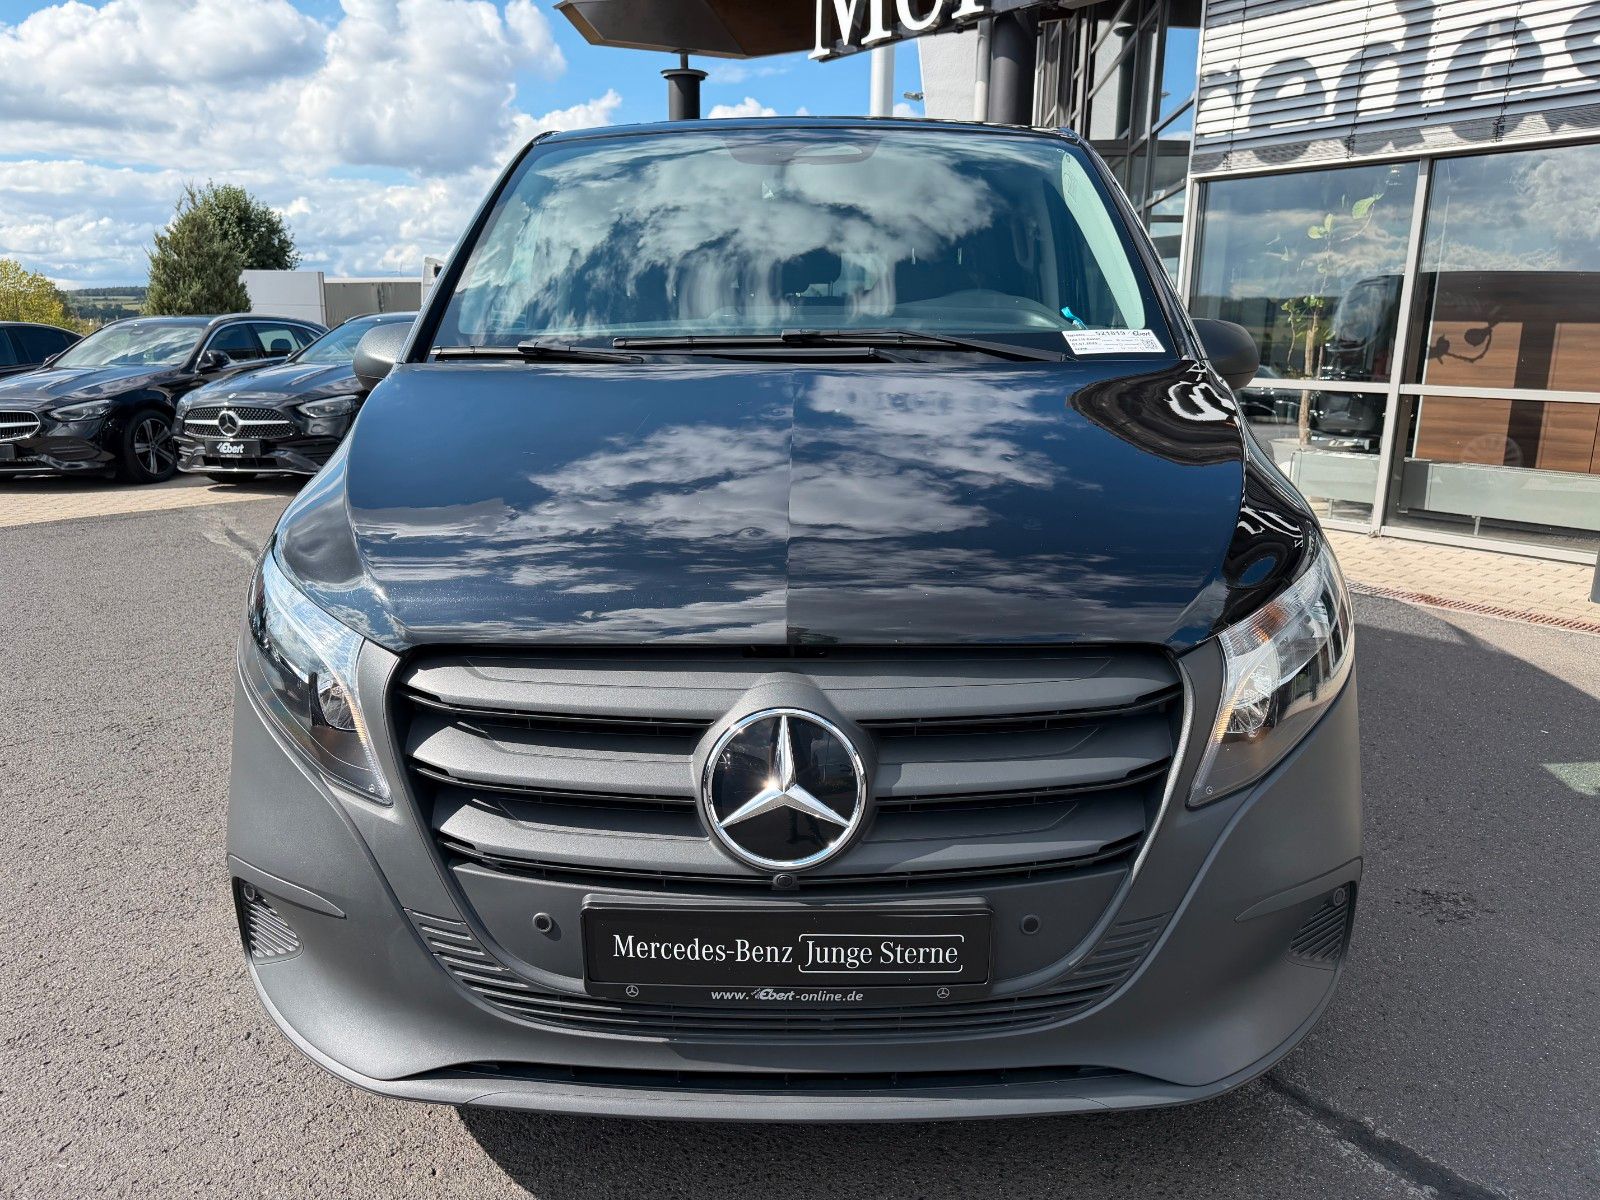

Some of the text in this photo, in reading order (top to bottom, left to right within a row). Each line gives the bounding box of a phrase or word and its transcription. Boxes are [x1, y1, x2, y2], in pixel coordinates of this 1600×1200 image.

[217, 442, 244, 453] Ebert
[612, 934, 958, 968] Mercedes-Benz Junge Sterne
